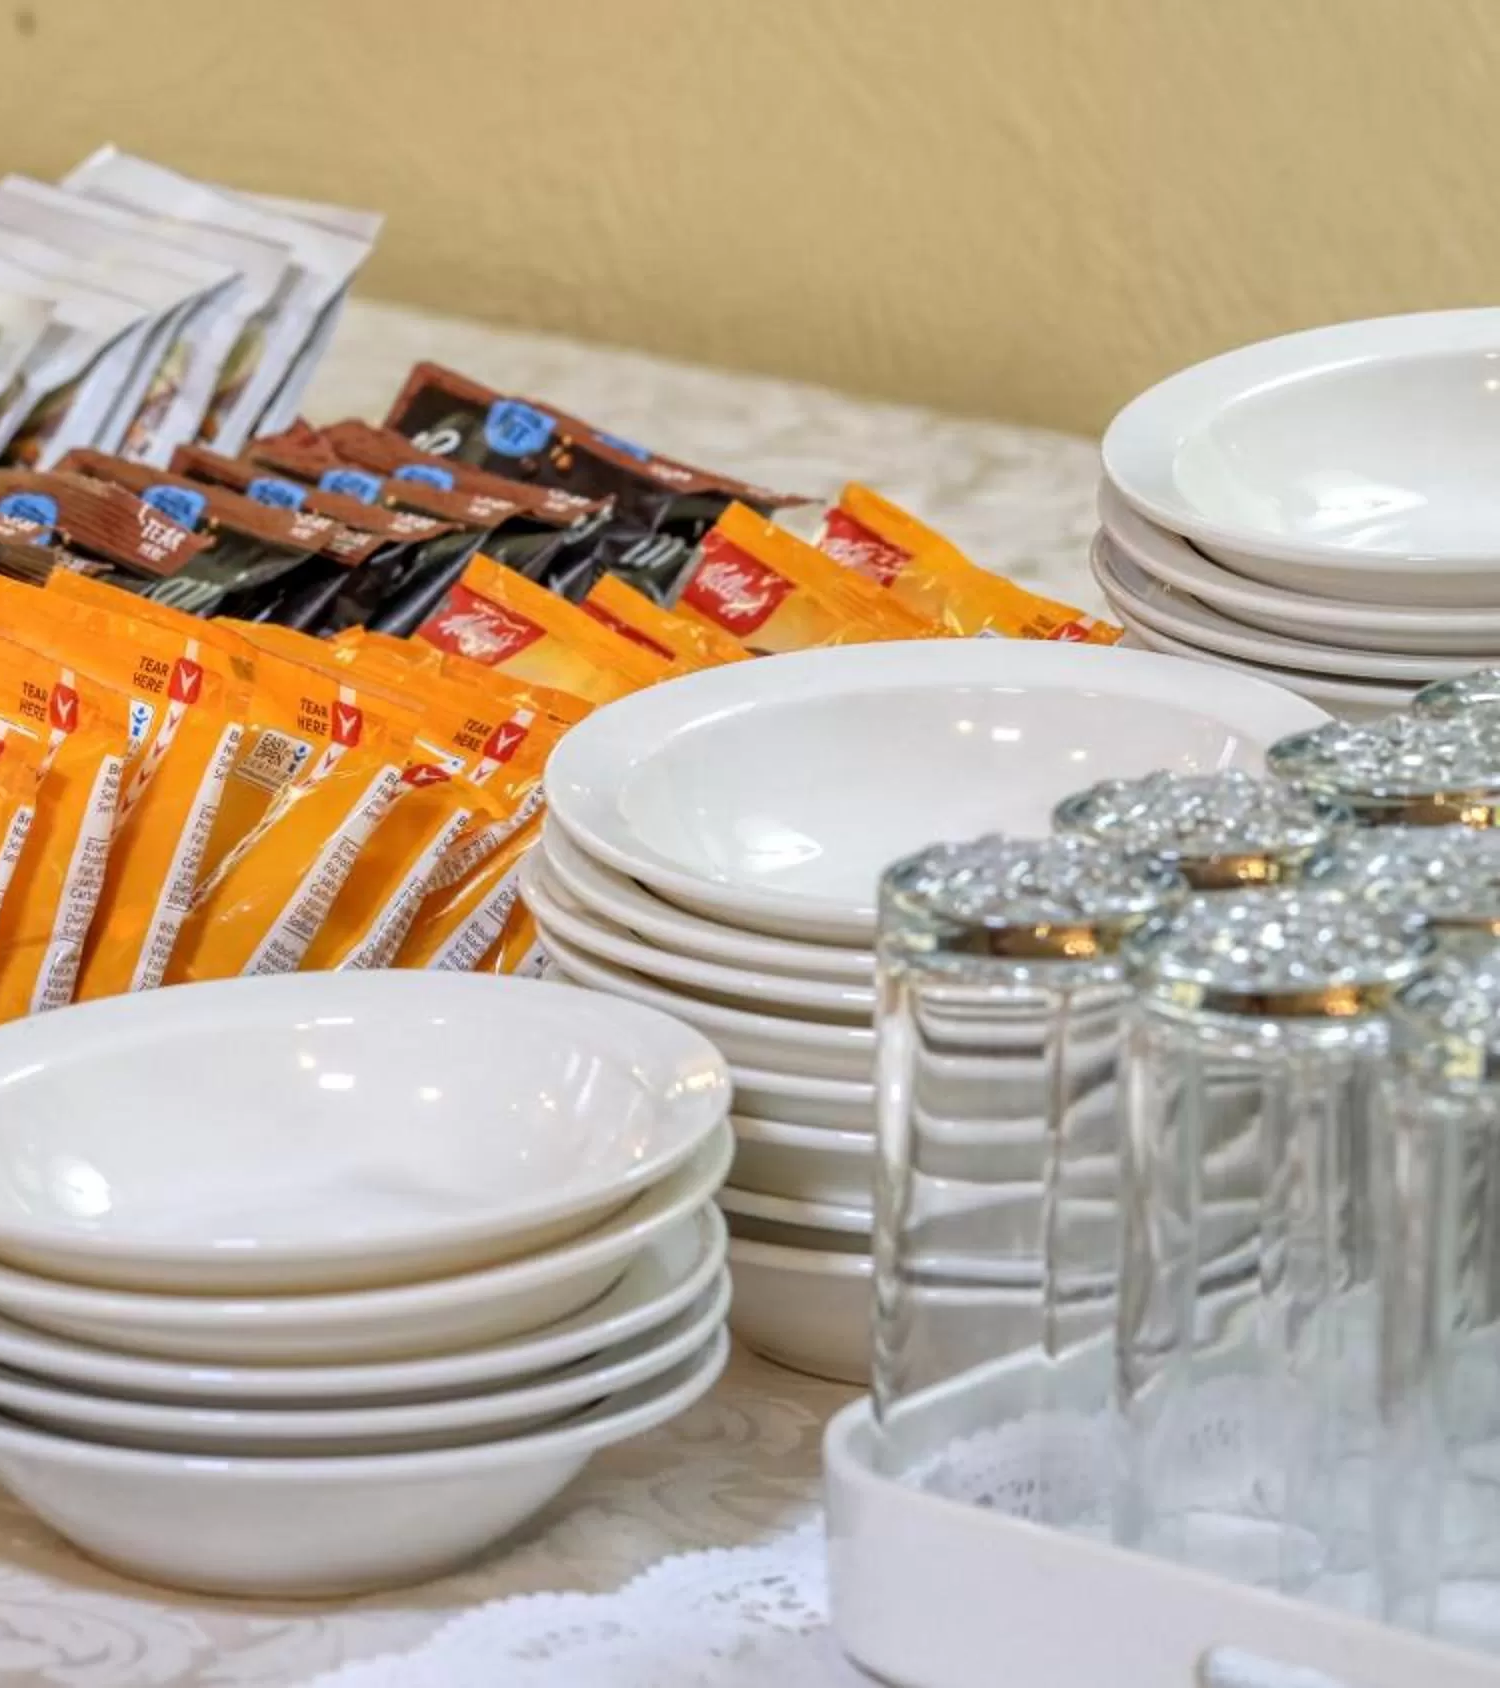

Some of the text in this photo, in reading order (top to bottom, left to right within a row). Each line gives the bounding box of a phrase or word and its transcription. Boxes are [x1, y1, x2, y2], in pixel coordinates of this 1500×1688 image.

[139, 656, 169, 676] TEAR
[23, 681, 49, 700] TEAR
[132, 672, 164, 693] HERE
[19, 700, 47, 722] HERE
[300, 697, 329, 718] TEAR
[297, 714, 329, 736] HERE
